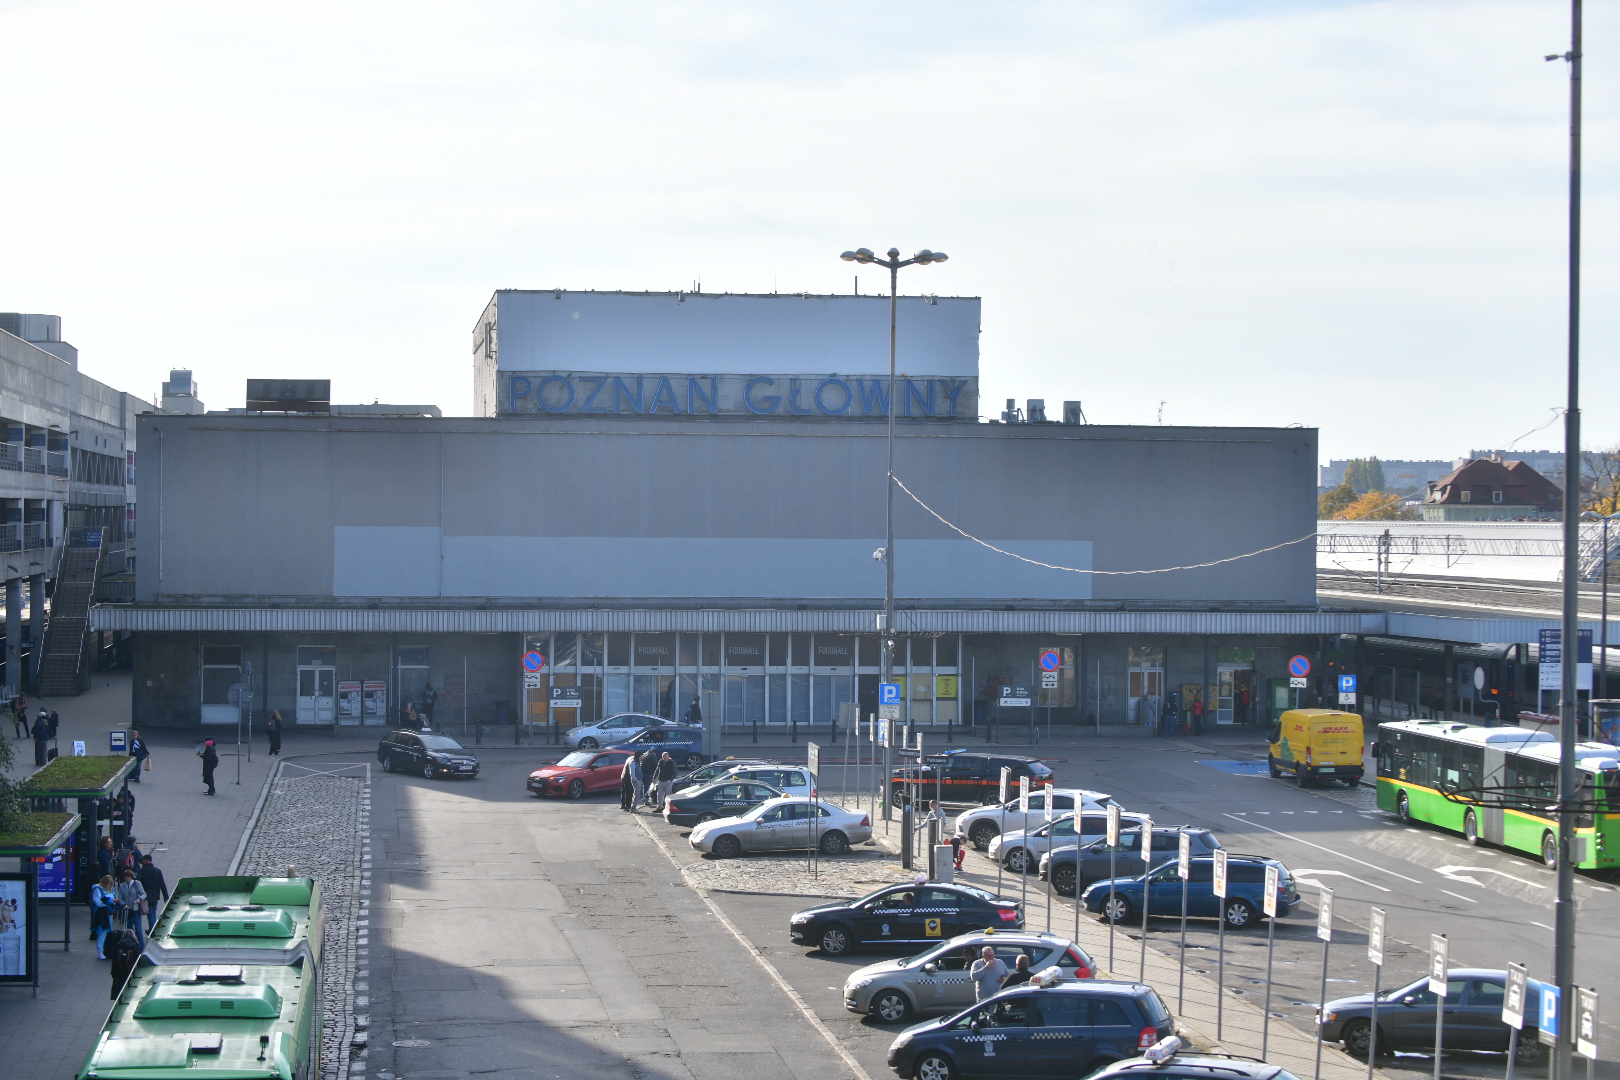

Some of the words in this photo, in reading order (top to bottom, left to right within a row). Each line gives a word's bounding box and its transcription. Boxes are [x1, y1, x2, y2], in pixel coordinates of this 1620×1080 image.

[743, 373, 969, 416] GŁÓWNY
[638, 646, 670, 655] FOODHALL
[728, 646, 760, 655] FOODHALL
[818, 646, 849, 655] FOODHALL
[1342, 676, 1353, 691] P
[553, 688, 561, 698] P
[883, 685, 897, 703] P
[1003, 686, 1011, 697] P
[1372, 912, 1384, 926] TAXI
[1433, 940, 1445, 954] TAXI
[1509, 968, 1524, 984] TAXI
[1543, 989, 1556, 1027] P
[1580, 994, 1595, 1011] TAXI
